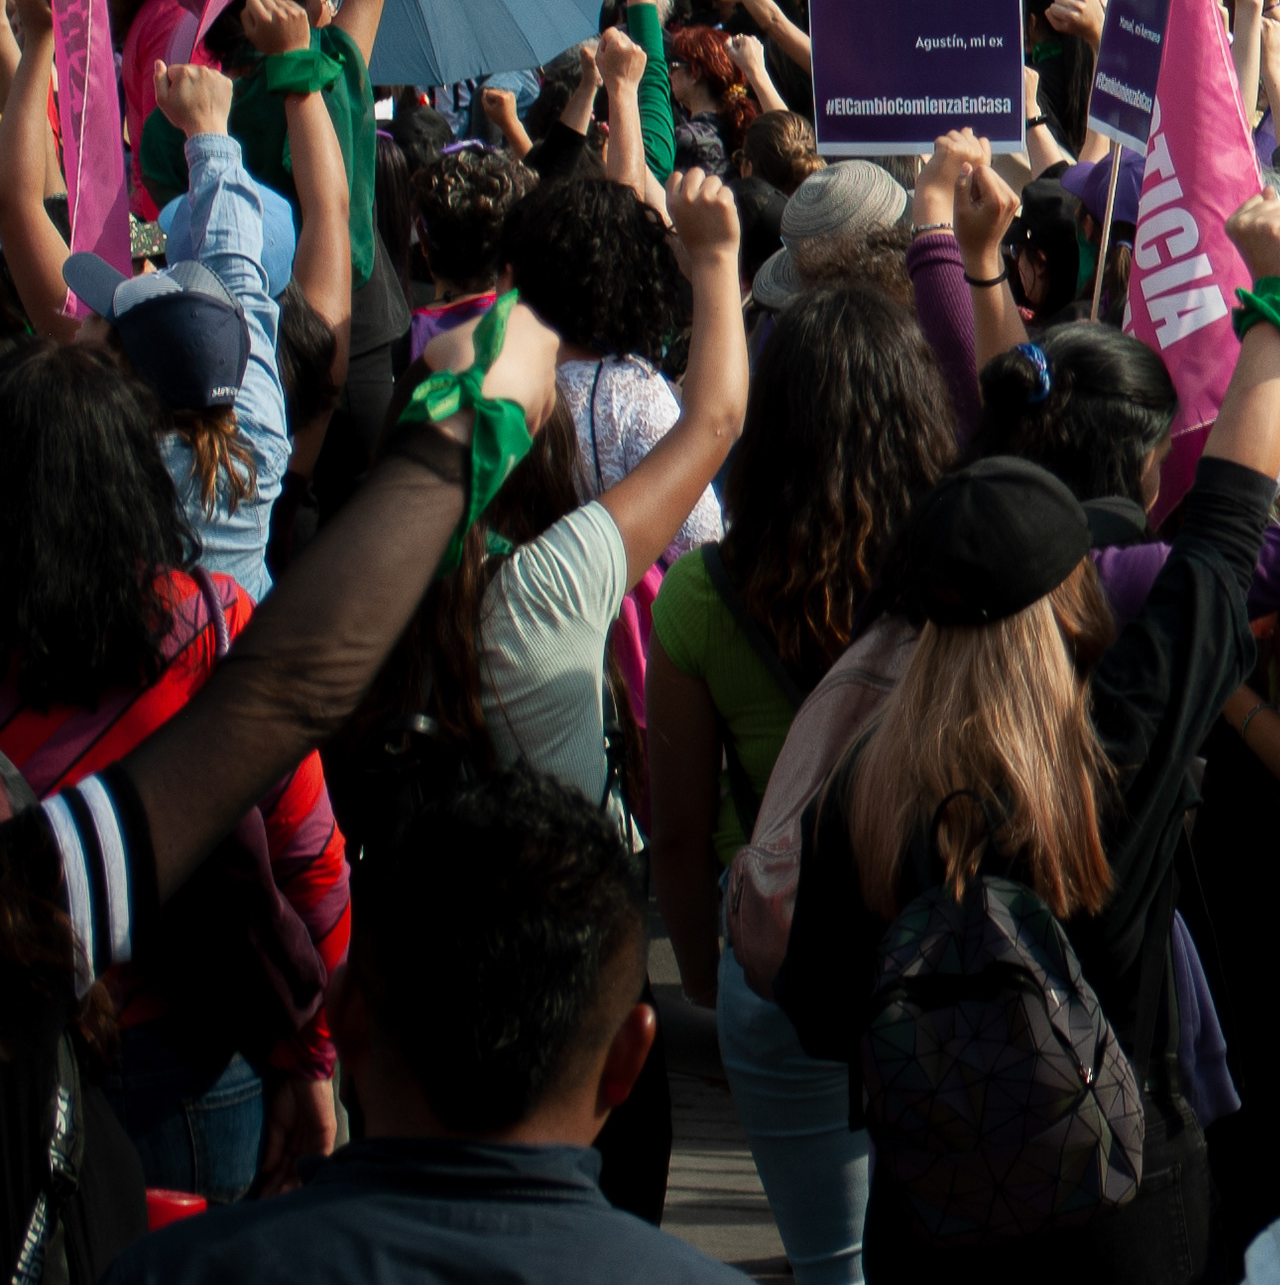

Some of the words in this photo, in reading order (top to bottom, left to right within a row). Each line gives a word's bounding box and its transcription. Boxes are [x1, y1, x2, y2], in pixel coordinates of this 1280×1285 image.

[915, 33, 968, 53] Agustín,
[969, 34, 986, 49] mi
[988, 36, 1004, 49] ex
[825, 95, 1013, 117] #ElCambioComienzaEnCasa
